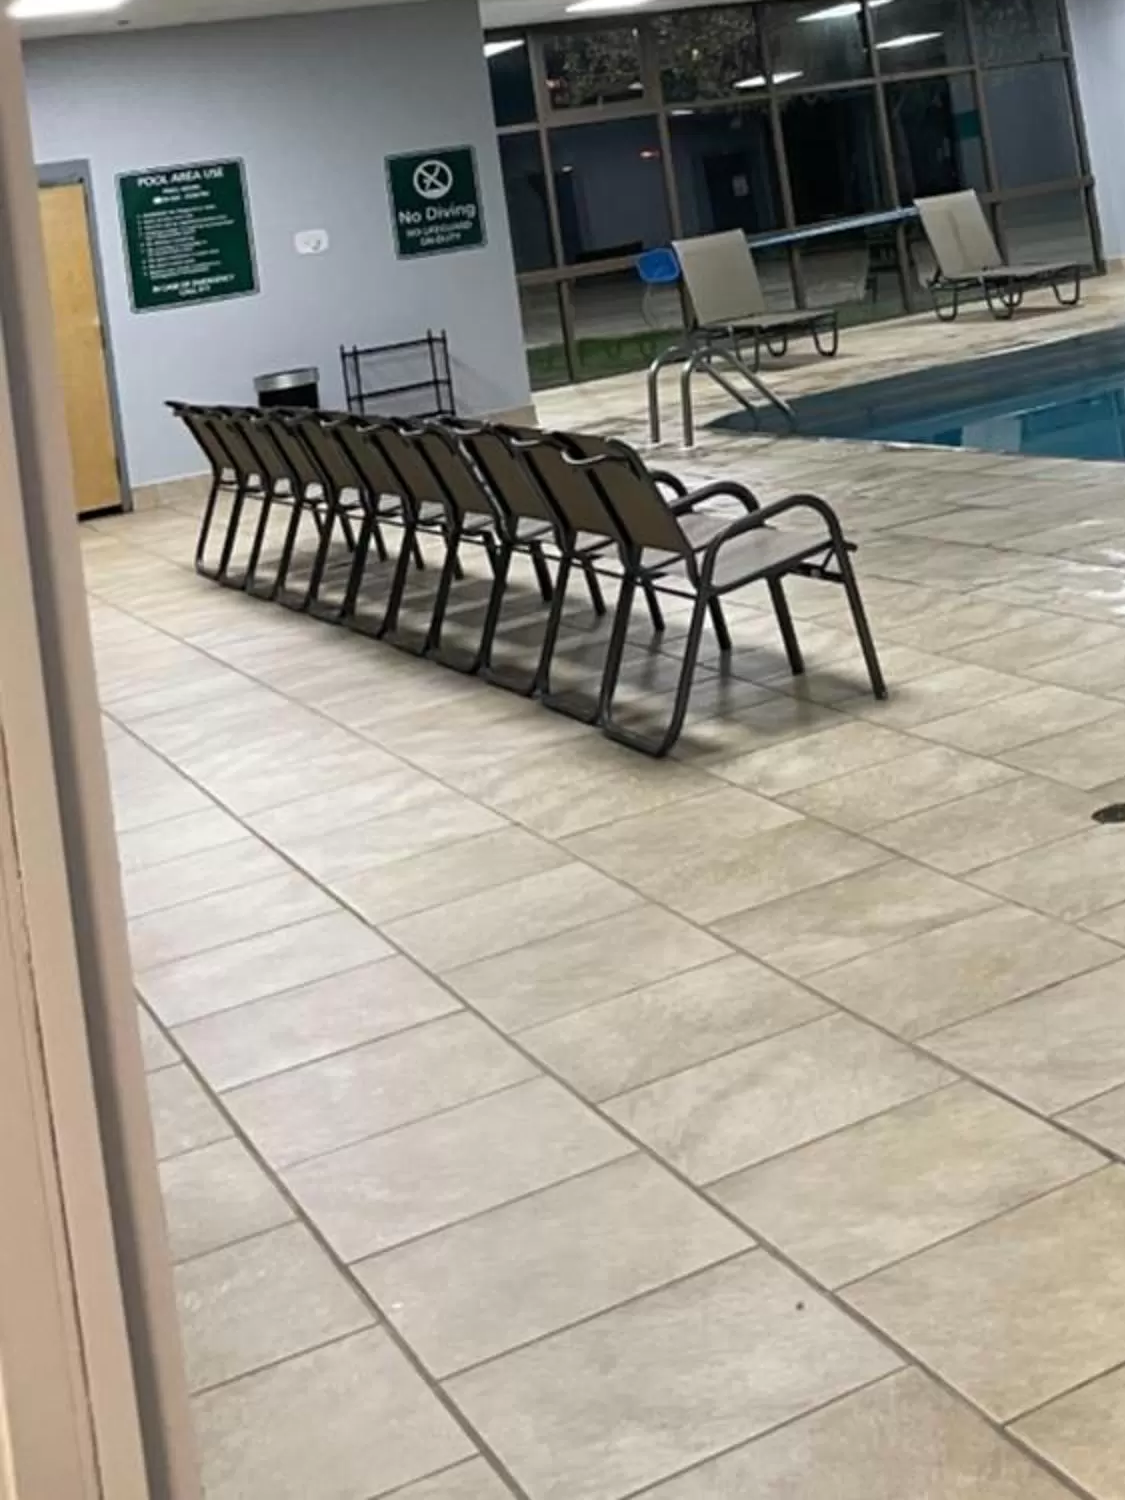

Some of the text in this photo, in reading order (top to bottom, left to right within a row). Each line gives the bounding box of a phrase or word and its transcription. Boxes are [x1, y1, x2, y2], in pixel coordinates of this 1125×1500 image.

[136, 174, 168, 188] POOL
[170, 169, 202, 183] AREA
[203, 165, 224, 180] USE
[398, 202, 477, 225] No Diving
[405, 227, 421, 238] NO
